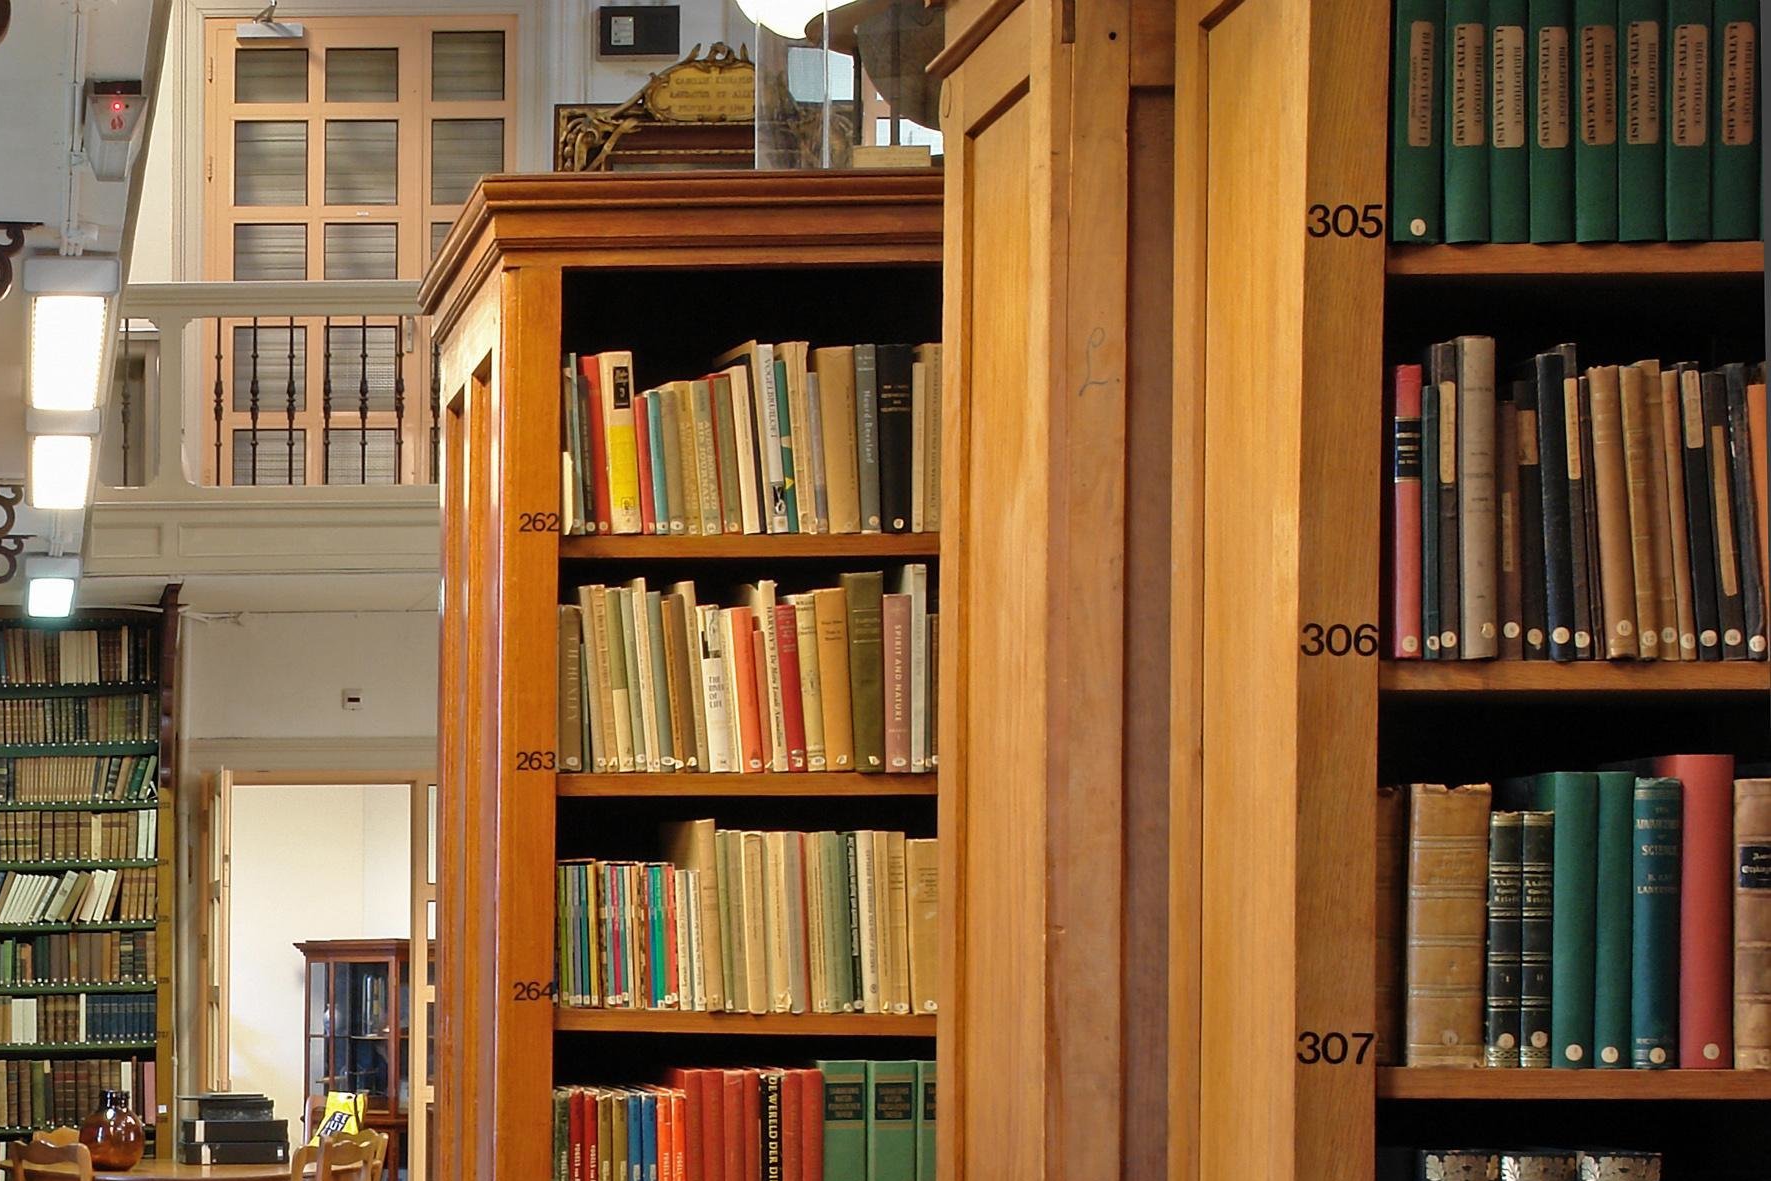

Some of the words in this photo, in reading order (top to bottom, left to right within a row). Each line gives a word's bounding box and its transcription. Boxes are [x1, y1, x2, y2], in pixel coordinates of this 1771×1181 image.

[1307, 204, 1383, 238] 305
[518, 512, 560, 532] 262
[1300, 622, 1379, 657] 306
[515, 751, 556, 771] 263
[512, 981, 555, 1001] 264
[1296, 1031, 1375, 1066] 307
[768, 1076, 778, 1092] DE
[768, 1093, 778, 1139] WERELD
[768, 1142, 778, 1164] DER
